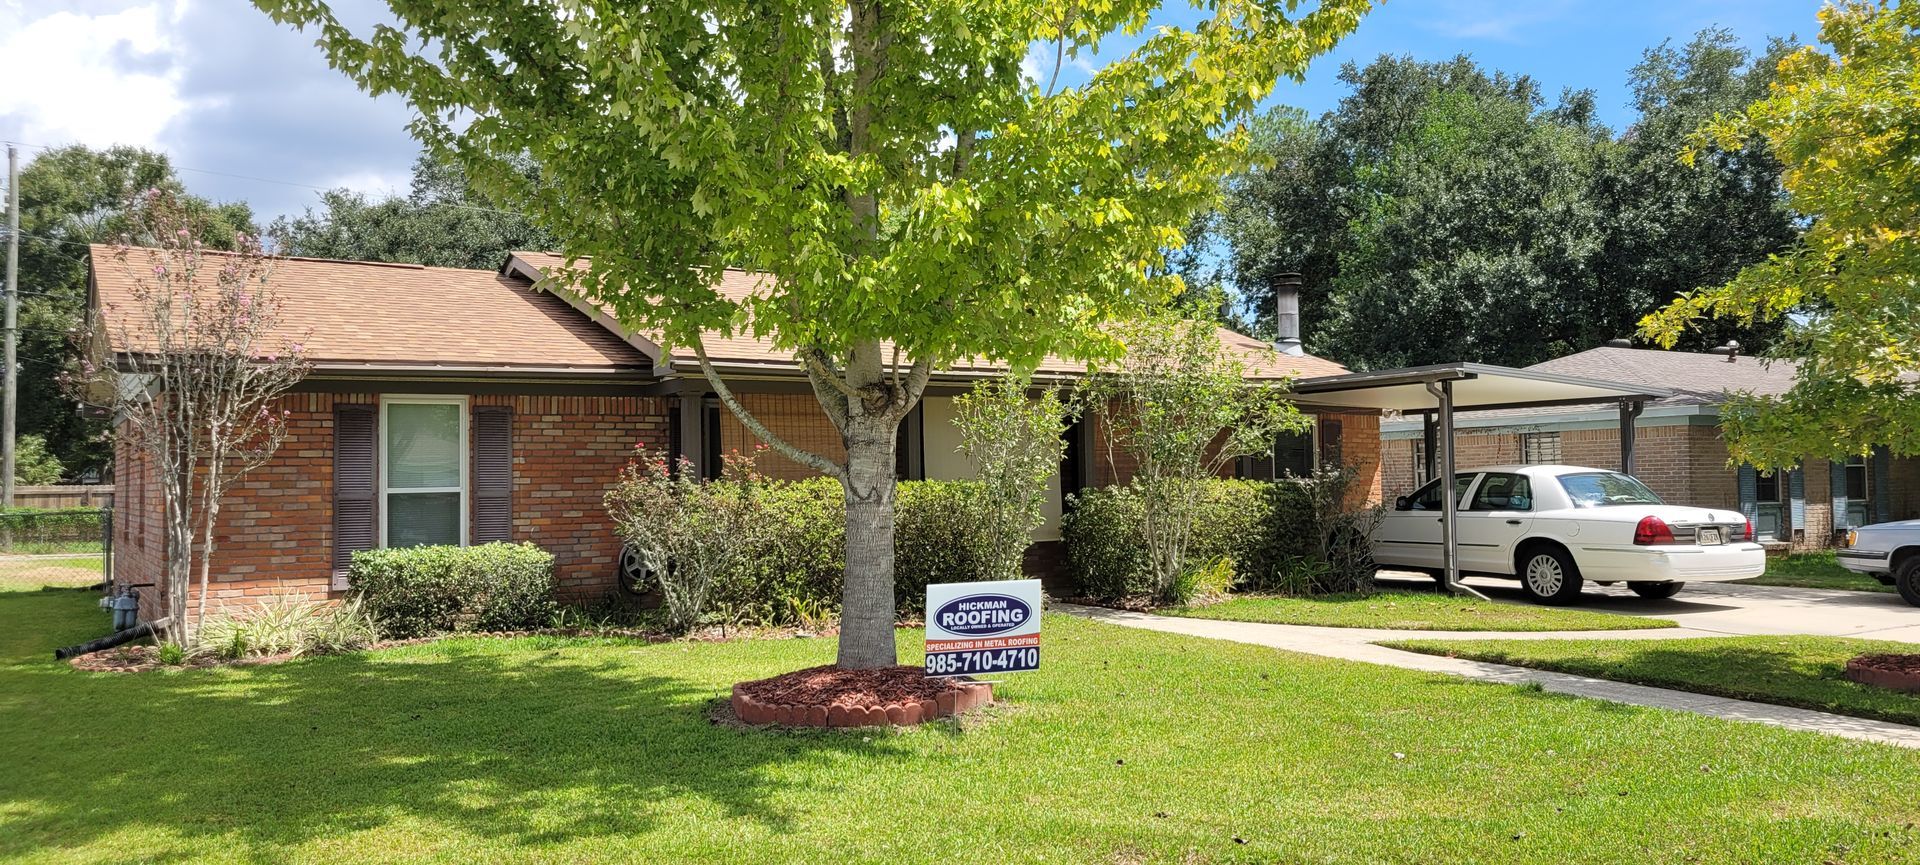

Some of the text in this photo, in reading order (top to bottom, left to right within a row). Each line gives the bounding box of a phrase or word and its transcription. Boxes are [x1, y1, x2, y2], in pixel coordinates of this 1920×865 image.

[958, 601, 1007, 611] HICKMAN
[942, 608, 1023, 626] ROOFING
[926, 637, 1038, 651] SPECIALIZING IN METAL ROOFING
[926, 648, 1038, 674] 985-710-4710
